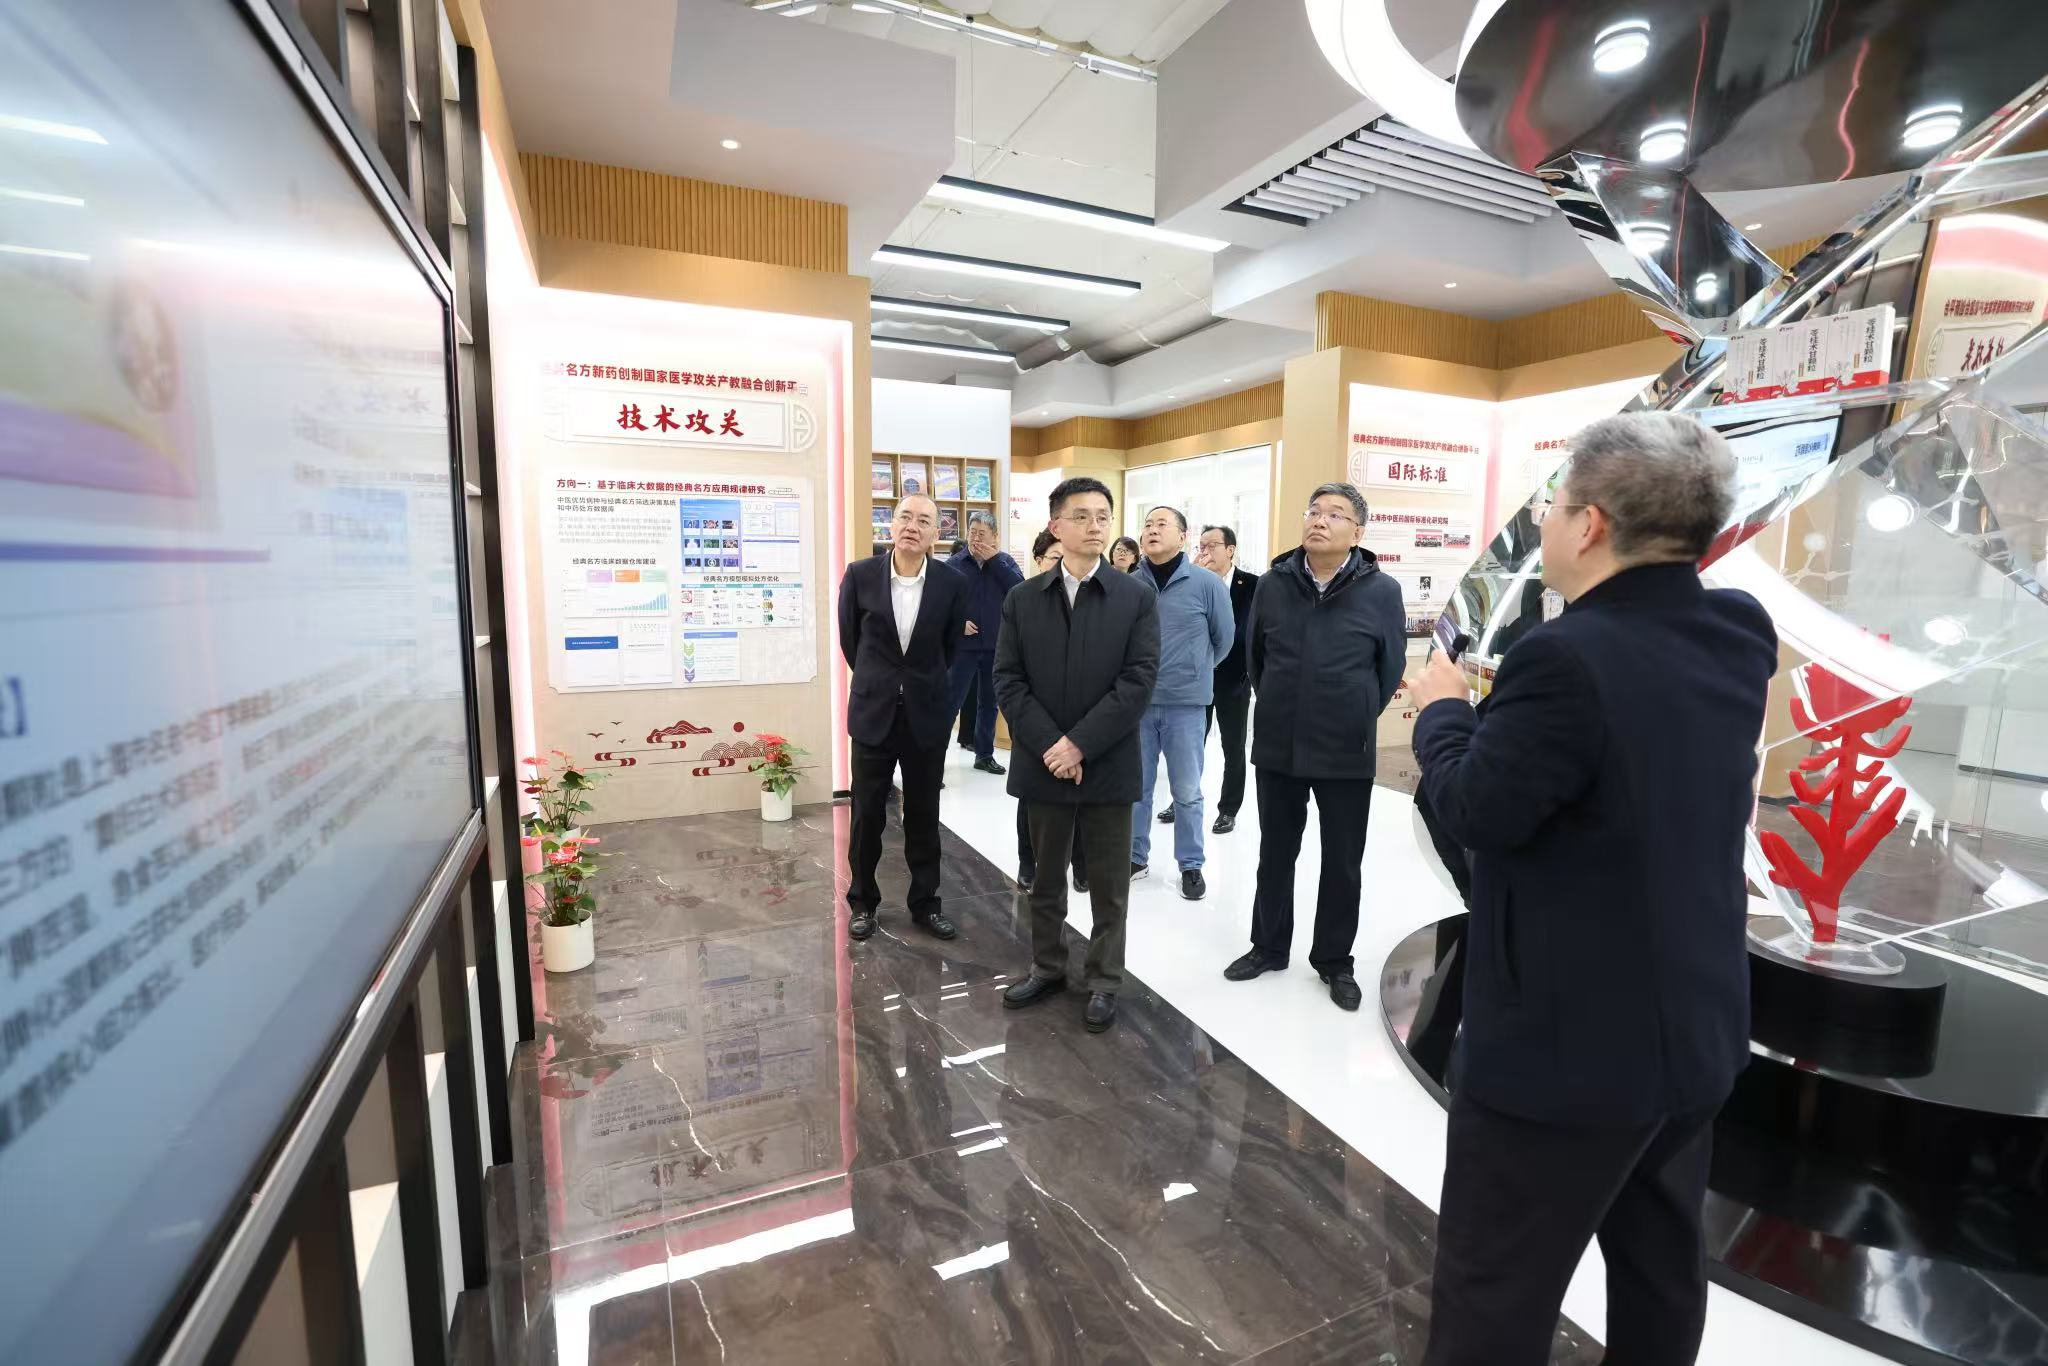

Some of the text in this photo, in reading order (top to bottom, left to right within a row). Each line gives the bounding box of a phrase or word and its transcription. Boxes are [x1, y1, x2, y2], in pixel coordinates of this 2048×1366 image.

[545, 362, 808, 396] 名方新药创制国家医学攻关产教融合创新平
[616, 403, 744, 437] 技术攻关
[1388, 461, 1448, 483] 国际标准
[1374, 554, 1401, 562] 国际标准
